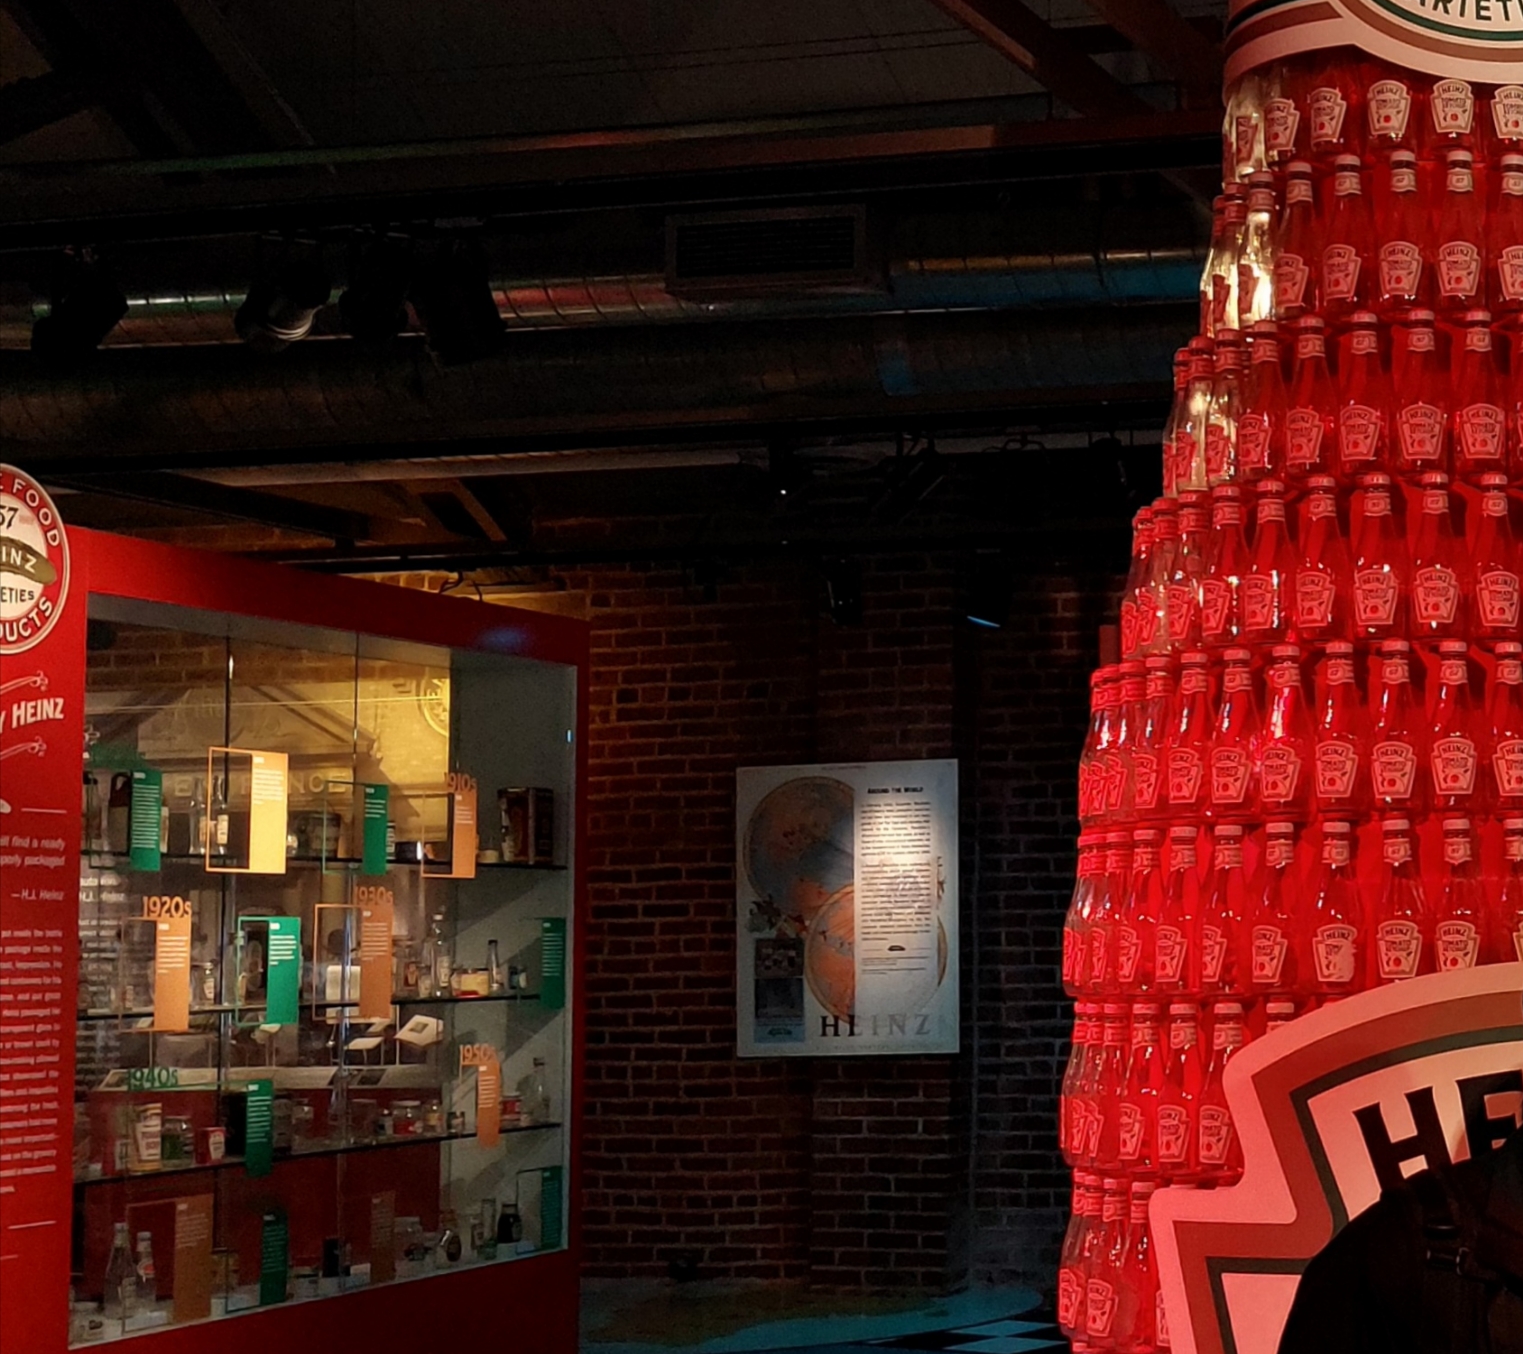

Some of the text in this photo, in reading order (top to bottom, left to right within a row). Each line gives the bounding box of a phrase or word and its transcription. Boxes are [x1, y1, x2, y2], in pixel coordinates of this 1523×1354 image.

[13, 478, 61, 547] FOOD
[2, 548, 37, 574] INZ
[12, 697, 64, 729] HEINZ
[444, 772, 477, 793] 1910s
[142, 896, 192, 919] 1920s
[1384, 926, 1410, 936] HEINZ
[1442, 927, 1467, 937] HEINZ
[819, 1013, 932, 1038] HEINZ
